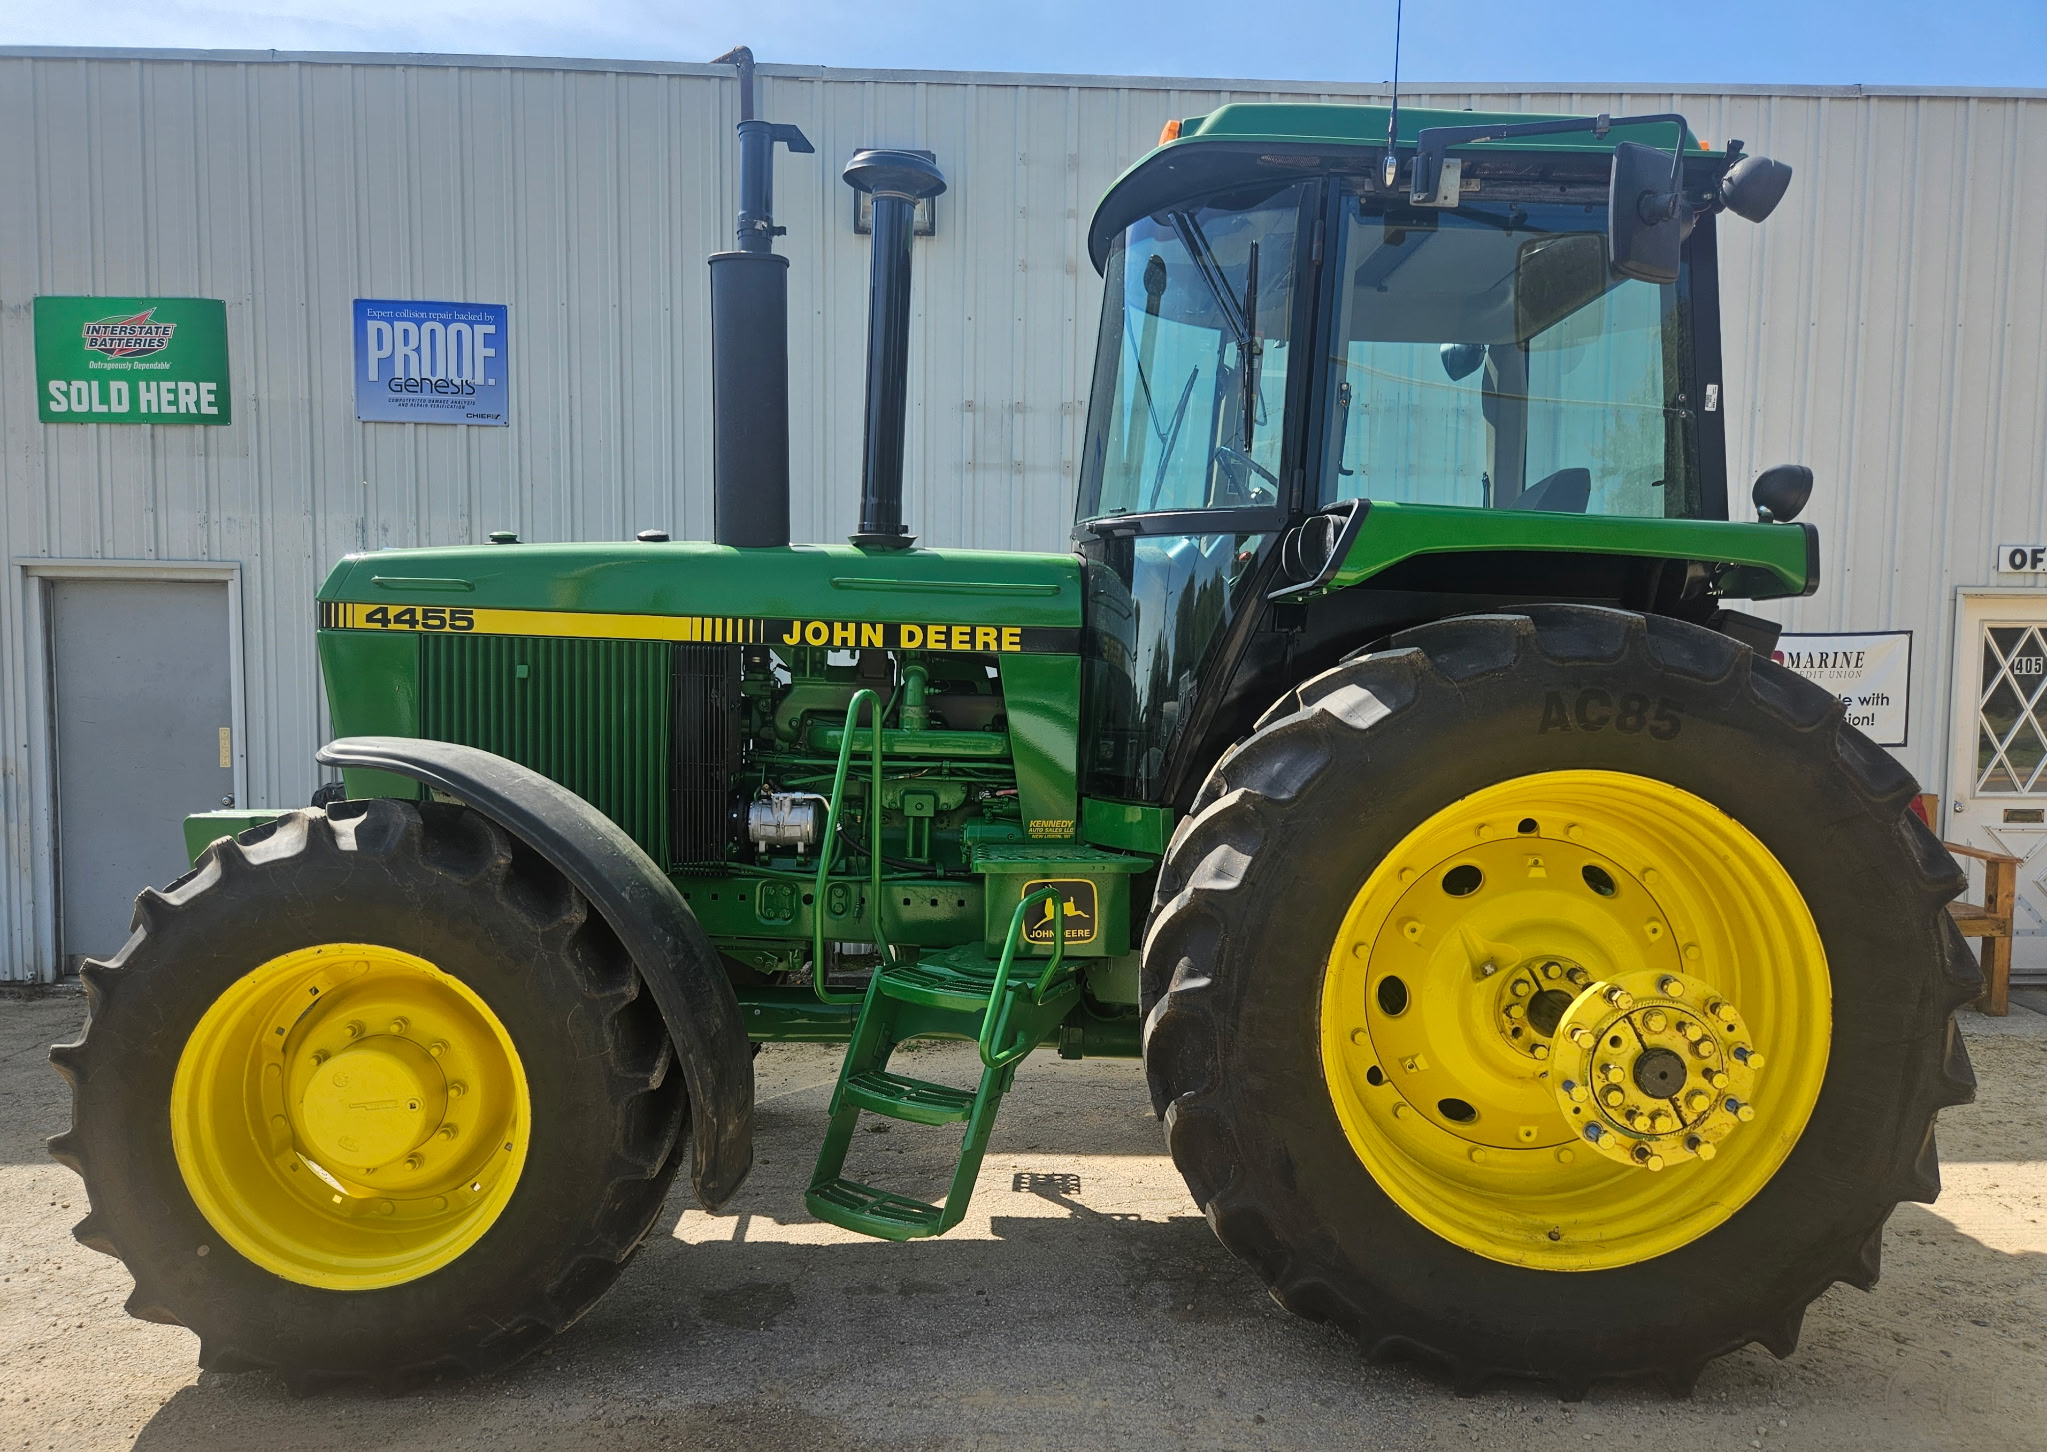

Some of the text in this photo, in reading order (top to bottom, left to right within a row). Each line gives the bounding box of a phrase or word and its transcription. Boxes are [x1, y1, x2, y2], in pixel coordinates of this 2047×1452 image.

[367, 308, 495, 323] Expert collision repair backed by
[85, 325, 172, 336] INTERSTATE
[89, 337, 165, 348] BATTERIES
[367, 320, 496, 386] PROOF.
[89, 361, 132, 370] Outrageously
[49, 380, 219, 415] SOLD HERE
[365, 606, 475, 631] 4455
[783, 620, 1022, 652] JOHN DEERE
[1787, 651, 1866, 669] MARINE
[2015, 657, 2042, 674] 405
[1797, 670, 1863, 679] EDIT UNION
[1858, 693, 1890, 706] with
[1537, 687, 1685, 741] AC85
[1029, 820, 1074, 828] KENNEDY
[1064, 929, 1091, 938] EERE
